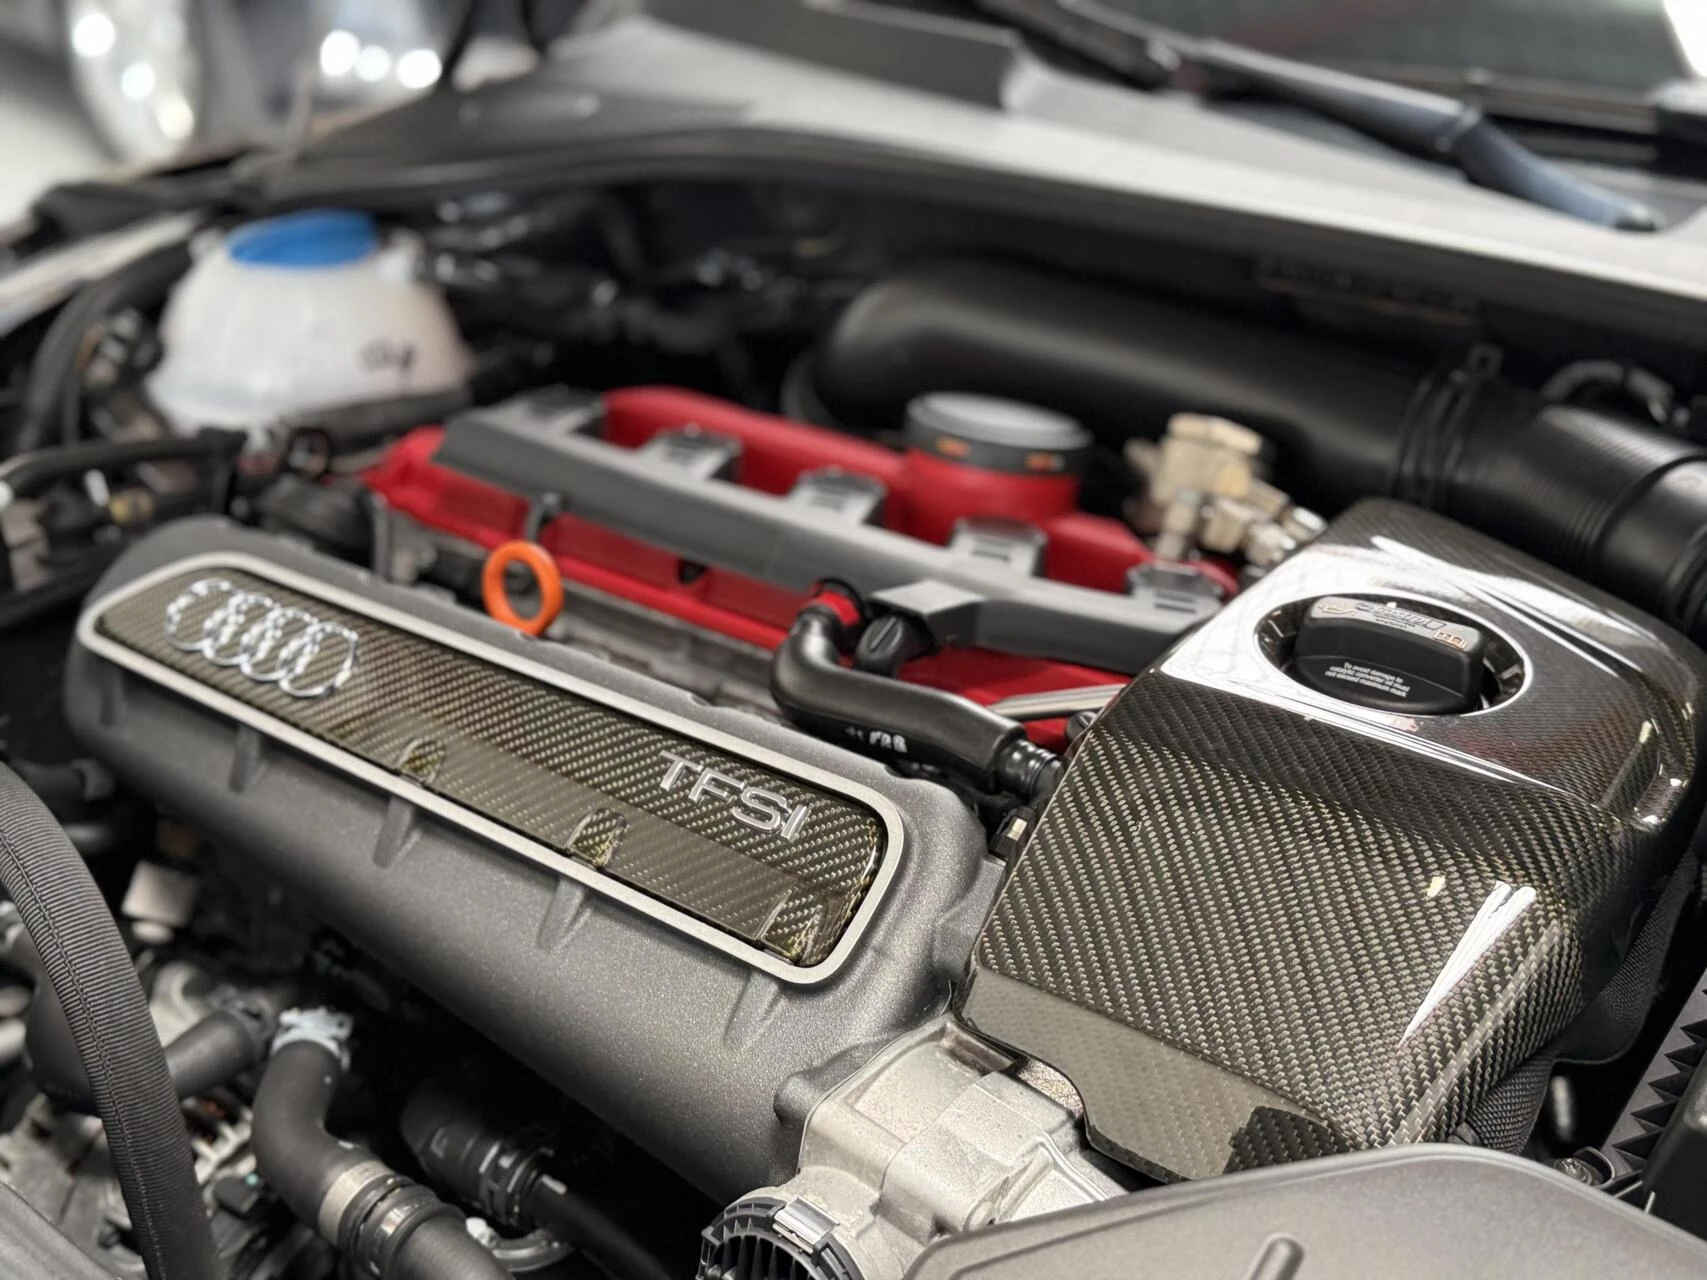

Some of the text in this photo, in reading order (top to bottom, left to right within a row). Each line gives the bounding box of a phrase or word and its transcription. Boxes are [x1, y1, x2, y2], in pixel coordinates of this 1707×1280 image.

[1352, 665, 1371, 674] avoid
[1370, 670, 1396, 681] damage
[1355, 671, 1385, 683] converter
[1336, 673, 1360, 683] exceed
[1359, 679, 1391, 692] maximum
[659, 750, 810, 841] TFSI
